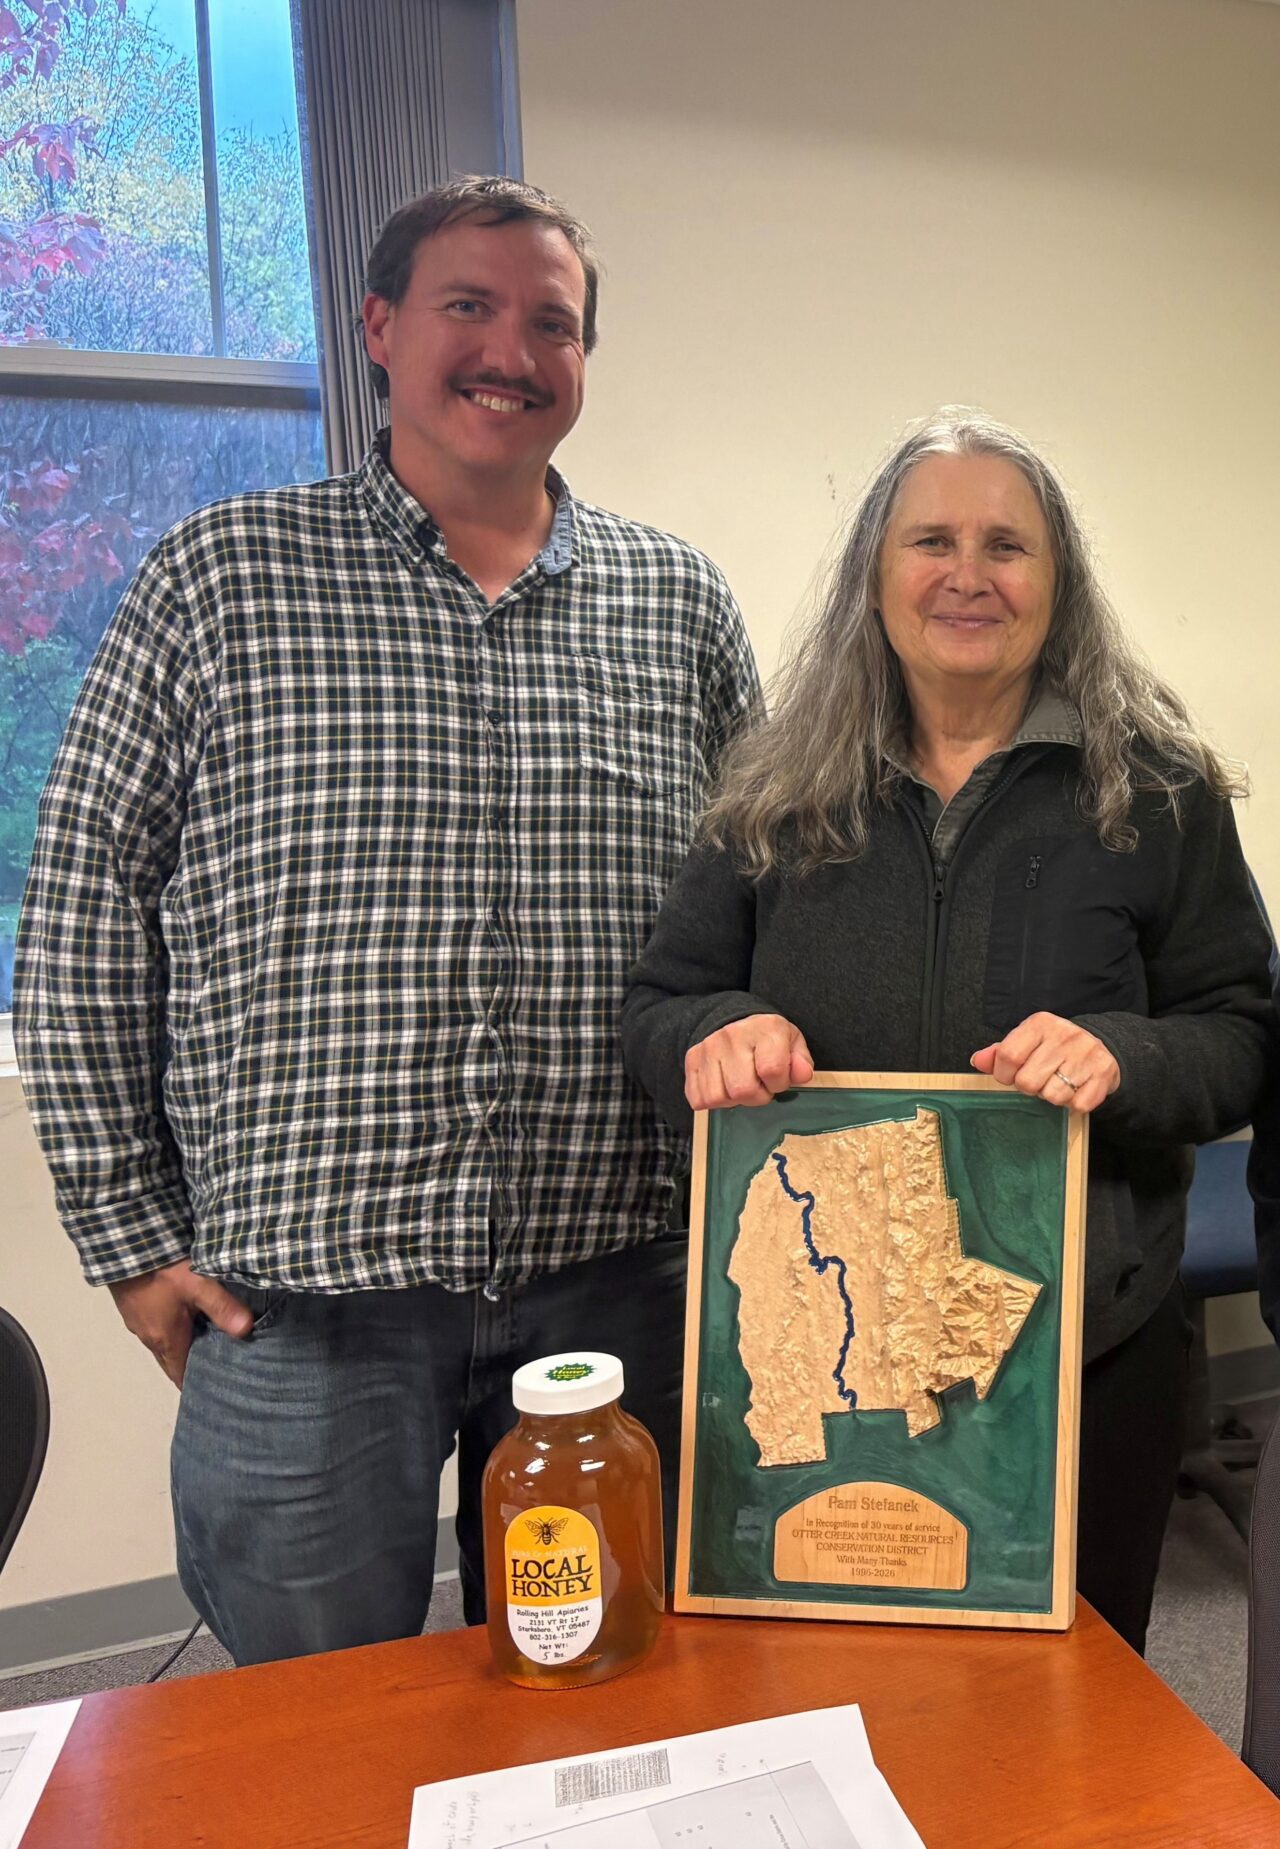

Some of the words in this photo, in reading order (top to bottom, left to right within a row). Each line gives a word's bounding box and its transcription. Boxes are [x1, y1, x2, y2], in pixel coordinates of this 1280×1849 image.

[828, 1495, 857, 1509] Pam
[861, 1496, 919, 1512] Stefanek
[815, 1518, 859, 1530] Recognition
[861, 1521, 869, 1529] of
[870, 1521, 881, 1529] 30
[883, 1523, 903, 1532] years
[905, 1522, 913, 1532] of
[915, 1524, 940, 1533] service
[792, 1529, 823, 1539] OTTER
[824, 1530, 855, 1540] CREEK
[856, 1532, 897, 1542] NATURAL
[900, 1533, 954, 1545] RESOURCES
[816, 1542, 884, 1553] CONSERVATION
[886, 1545, 929, 1555] DISTRICT
[511, 1554, 593, 1579] LOCAL
[836, 1554, 855, 1564] With
[857, 1555, 878, 1567] Many
[879, 1556, 907, 1567] Thanks
[511, 1573, 594, 1597] HONEY
[516, 1609, 539, 1619] Rolling
[557, 1606, 589, 1616] Apiaries
[568, 1620, 590, 1630] 05487
[529, 1631, 578, 1640] 802-316-1307
[542, 1651, 551, 1660] 5
